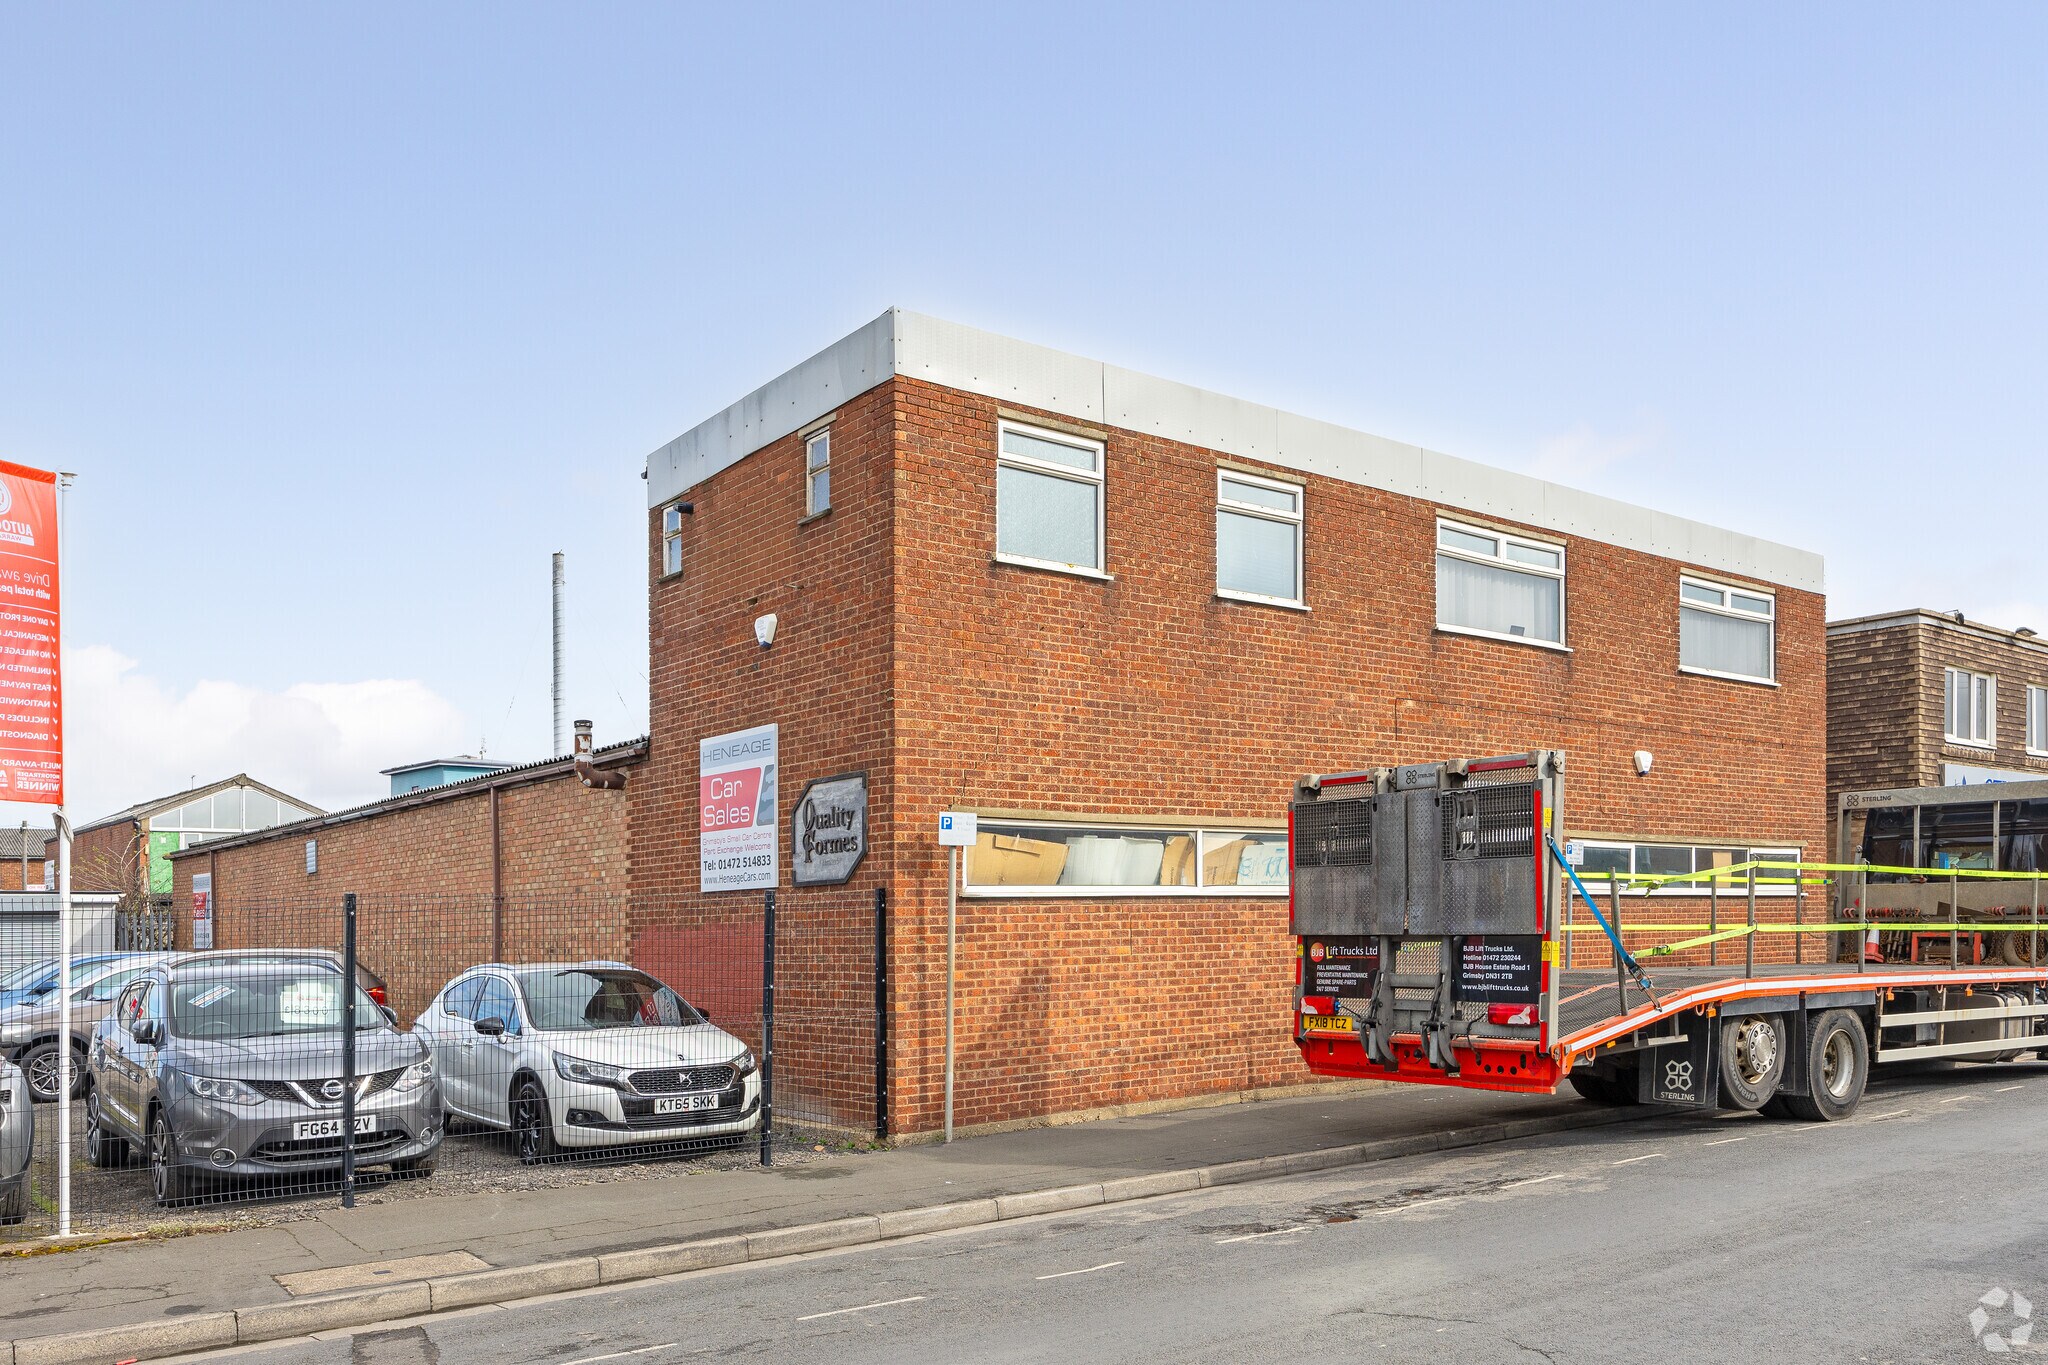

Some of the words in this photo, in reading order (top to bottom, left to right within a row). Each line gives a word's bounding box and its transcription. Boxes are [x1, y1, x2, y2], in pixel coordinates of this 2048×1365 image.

[702, 737, 772, 763] HENEAGE
[710, 777, 743, 800] Car
[1861, 795, 1892, 803] STERLING
[703, 802, 750, 827] Sales
[802, 798, 856, 831] Quality
[943, 817, 951, 829] P
[726, 834, 741, 843] Small
[741, 833, 752, 842] Car
[752, 831, 772, 841] Centre
[716, 845, 744, 855] Exchange
[744, 842, 772, 852] Welcome
[802, 829, 858, 863] Formes
[703, 859, 717, 871] Tel:
[718, 857, 741, 870] 01472
[742, 854, 772, 868] 514833
[703, 871, 772, 885] www.HeneageCars.com
[1311, 948, 1324, 957] BJB
[1325, 945, 1338, 960] Lift
[1339, 945, 1364, 956] Trucks
[1365, 945, 1378, 956] Ltd
[1492, 963, 1510, 971] Estate
[1462, 972, 1485, 980] Grimsby
[1461, 983, 1530, 992] www.bjblifttrucks.co.uk
[1330, 1017, 1347, 1029] TCZ
[659, 1097, 690, 1111] KT65
[692, 1095, 714, 1109] SKK
[1660, 1091, 1695, 1101] STERLING
[300, 1121, 339, 1137] FG64
